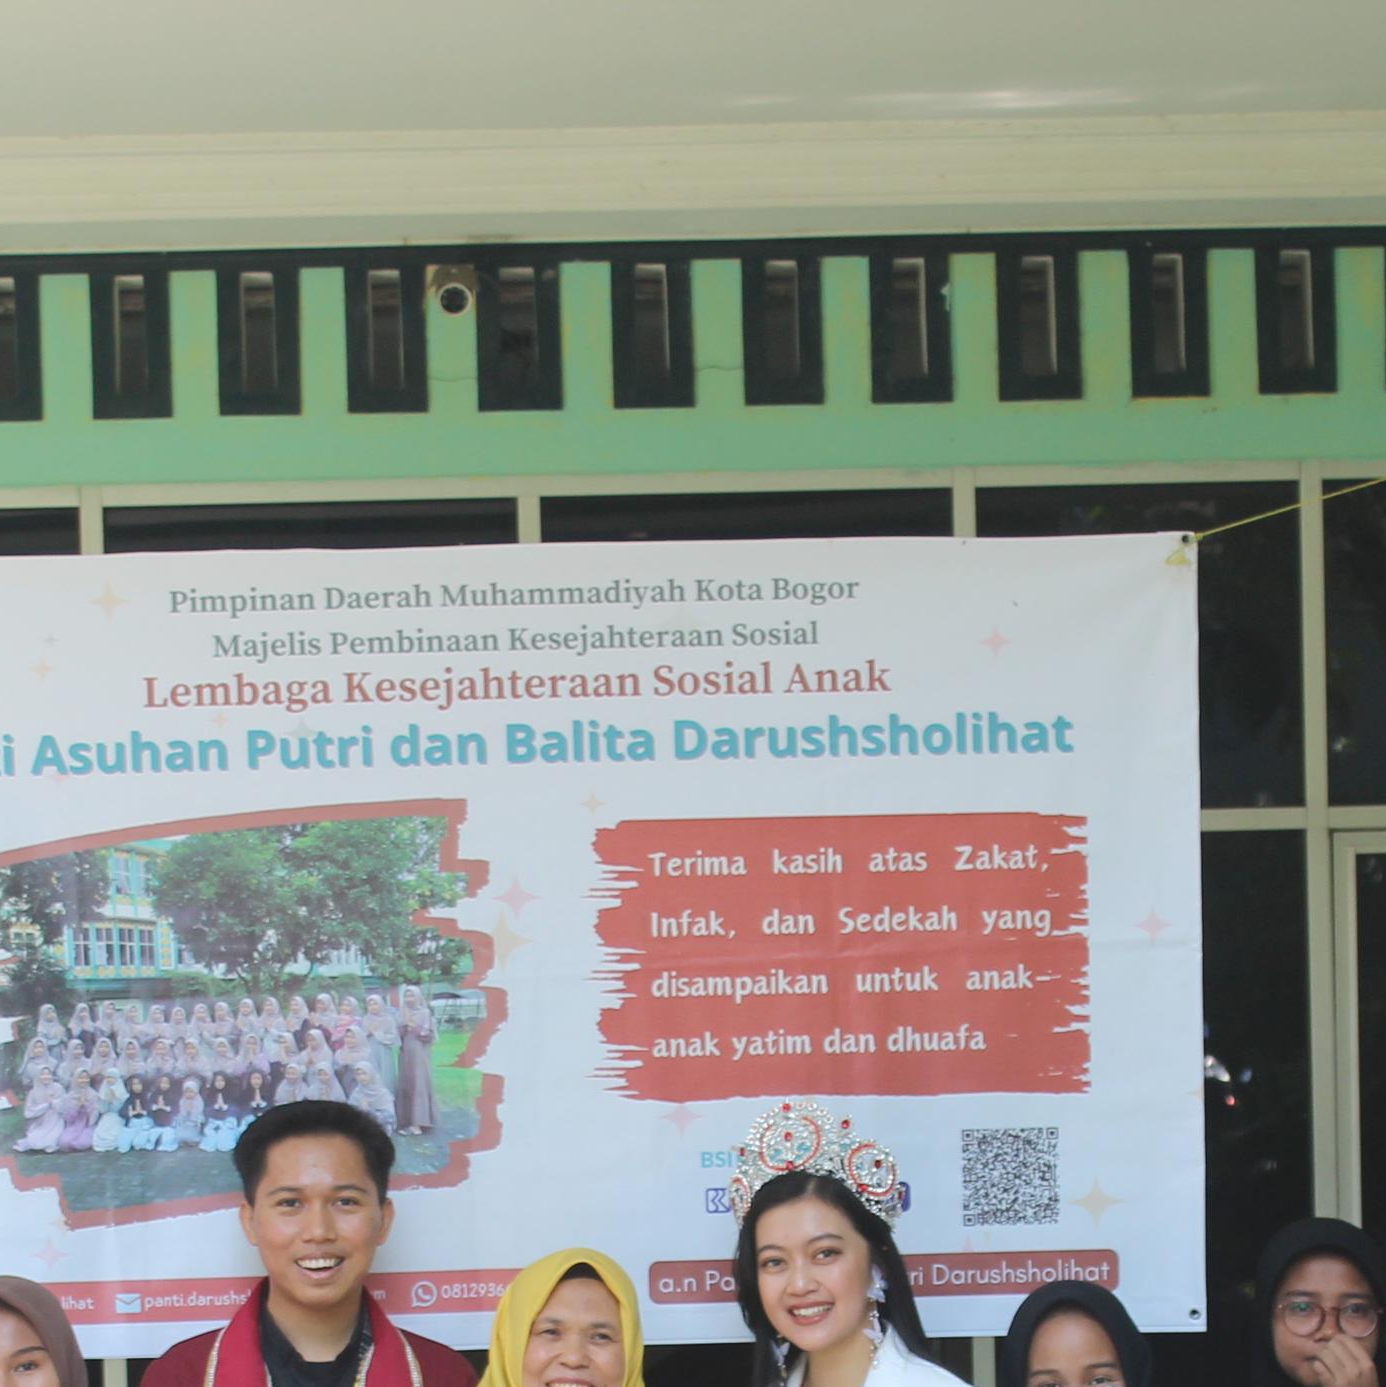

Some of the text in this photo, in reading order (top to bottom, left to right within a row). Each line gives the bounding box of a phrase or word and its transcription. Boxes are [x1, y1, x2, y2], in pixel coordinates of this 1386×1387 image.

[170, 578, 859, 618] Pimpinan Daerah Muhammadiyah Kota Bogor
[213, 621, 818, 663] Majelis Pembinaan Kesejahteraan Sosial
[144, 660, 891, 713] Lembaga Kesejahteraan Sosial Anak
[31, 731, 229, 776] Asuhan
[247, 725, 373, 770] Putri
[390, 724, 487, 767] dan
[506, 720, 655, 764] Balita
[674, 712, 1074, 760] Darushsholihat
[648, 844, 1050, 876] Terima kasih atas Zakat,
[651, 905, 1052, 938] Infak, dan Sedekah yang
[651, 969, 828, 1004] disampaikan
[856, 966, 938, 992] untuk
[653, 1024, 986, 1060] anak yatim dan dhuafa
[658, 1259, 1111, 1293] a.n Pa ri Darushsholihat
[61, 1282, 507, 1311] lihat panti.darushs 0812936
